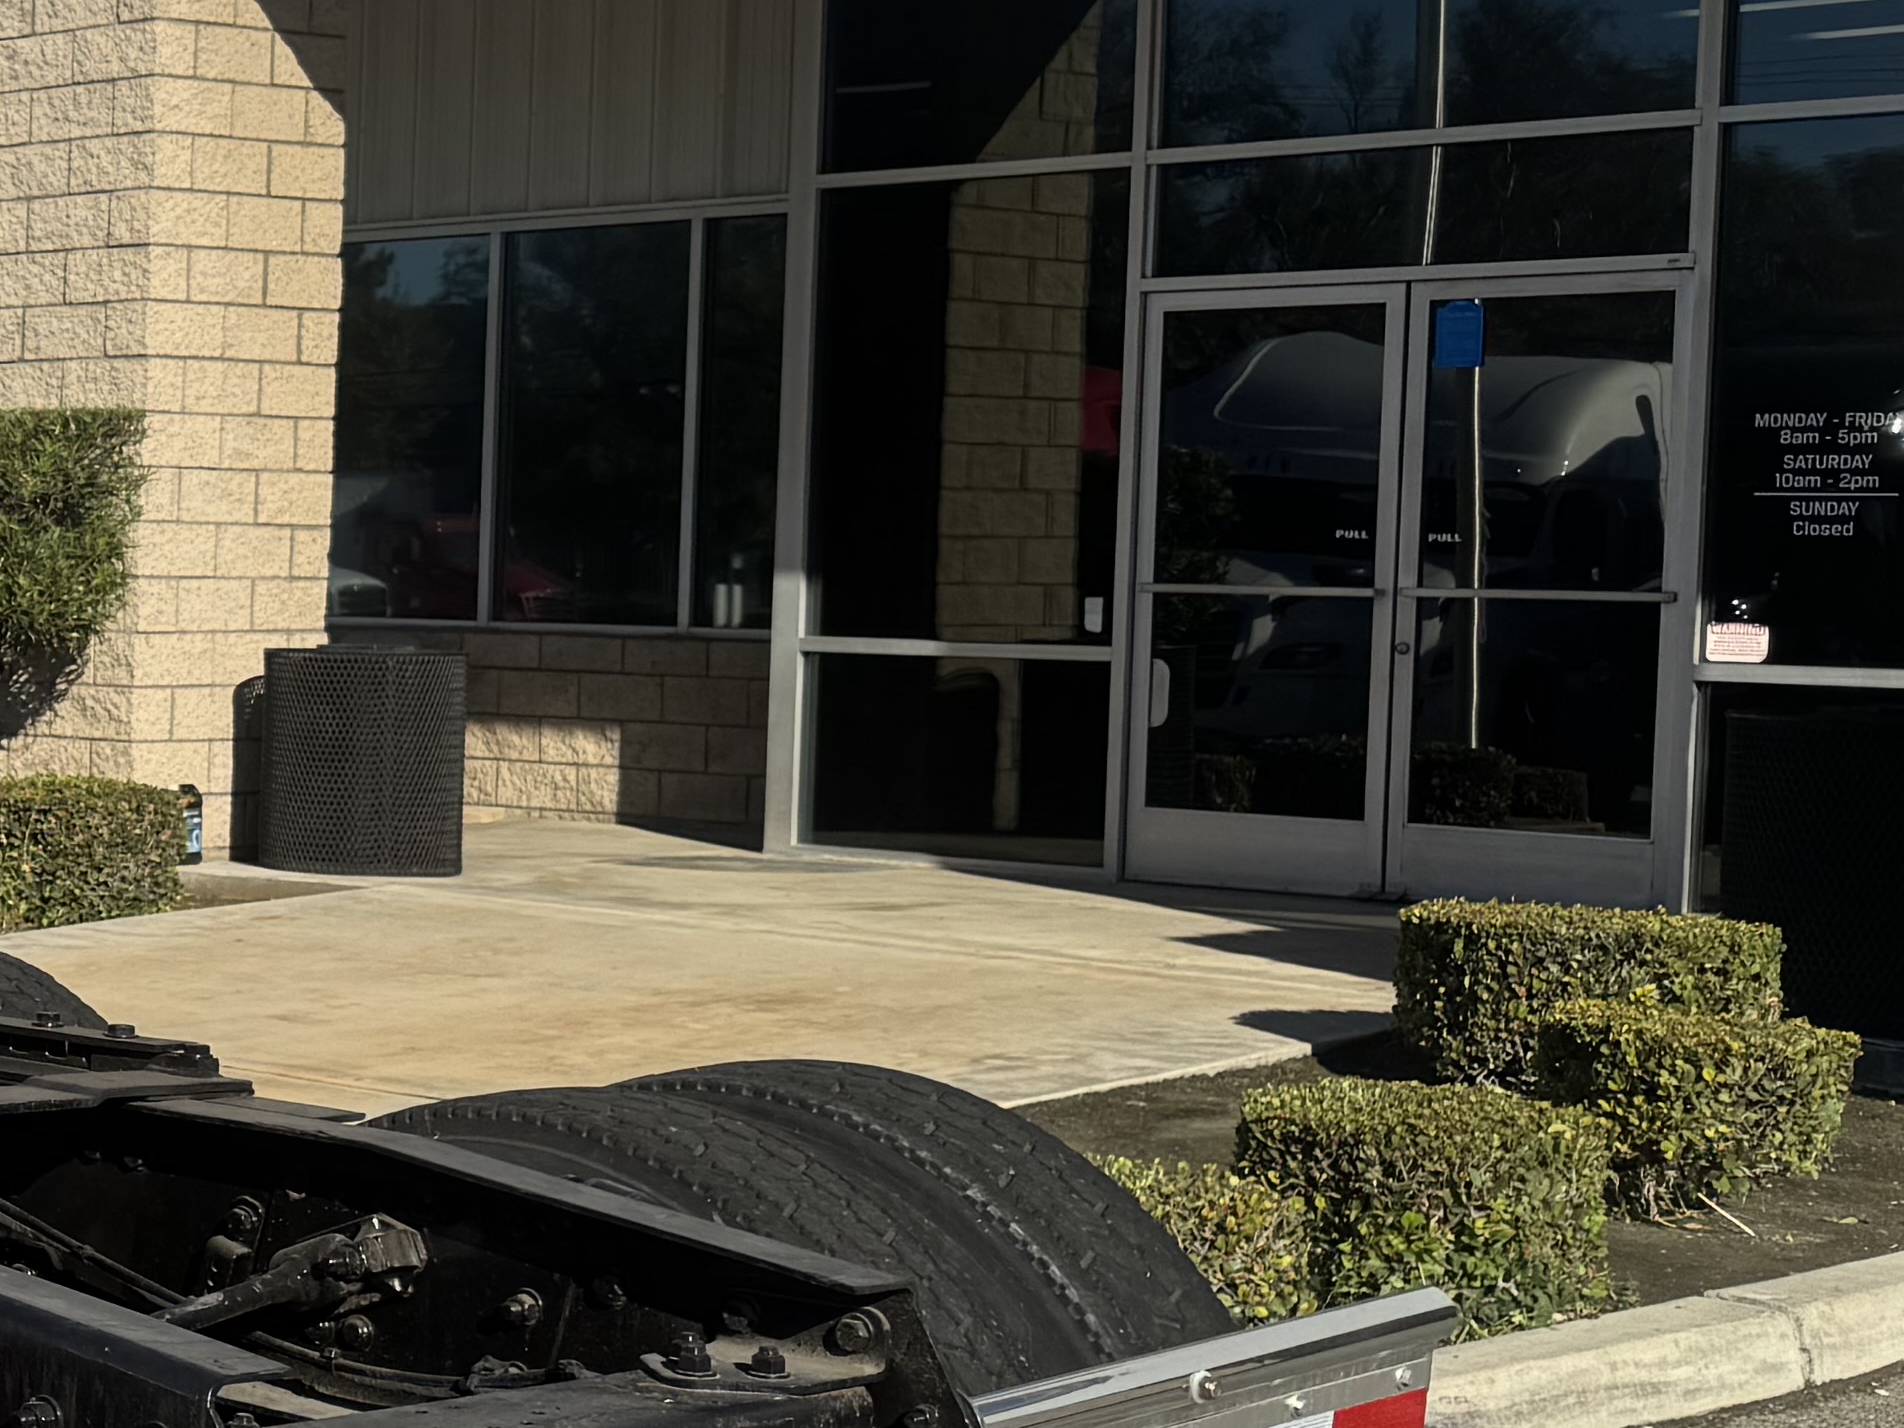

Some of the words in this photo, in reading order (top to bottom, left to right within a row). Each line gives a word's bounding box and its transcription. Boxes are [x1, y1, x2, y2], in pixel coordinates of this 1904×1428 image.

[1754, 412, 1828, 428] MONDAY
[1844, 412, 1901, 429] FRIDA
[1779, 429, 1820, 445] 8am
[1837, 429, 1878, 447] 5pm
[1783, 453, 1873, 469] SATURDAY
[1775, 473, 1821, 488] 10am
[1838, 473, 1880, 491] 2pm
[1789, 501, 1860, 516] SUNDAY
[1335, 529, 1369, 539] PULL
[1792, 521, 1854, 536] Closed
[1428, 533, 1462, 542] PULL
